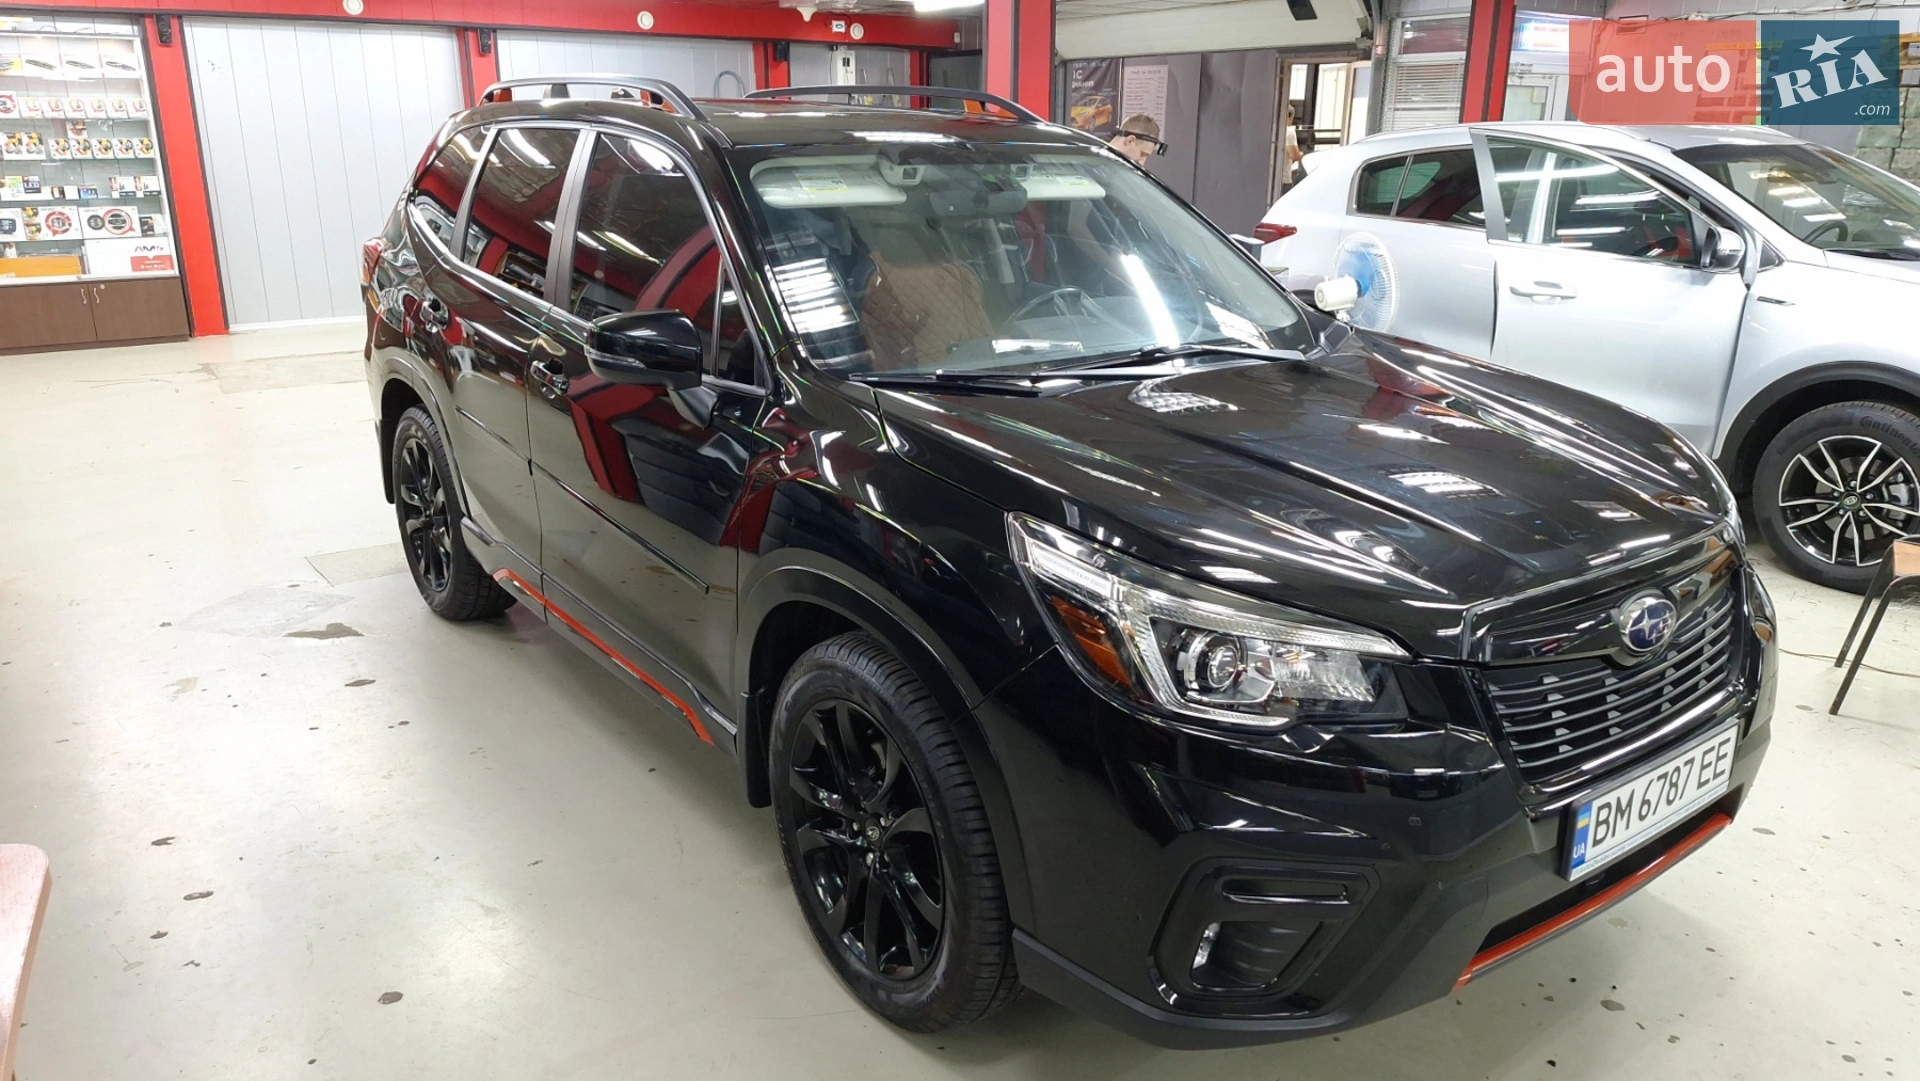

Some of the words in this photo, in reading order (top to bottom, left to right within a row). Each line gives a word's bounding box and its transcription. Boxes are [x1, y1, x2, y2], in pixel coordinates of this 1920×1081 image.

[1592, 788, 1635, 849] BM
[1638, 756, 1696, 822] 6787
[1697, 737, 1731, 790] EE
[1573, 842, 1585, 858] UA
